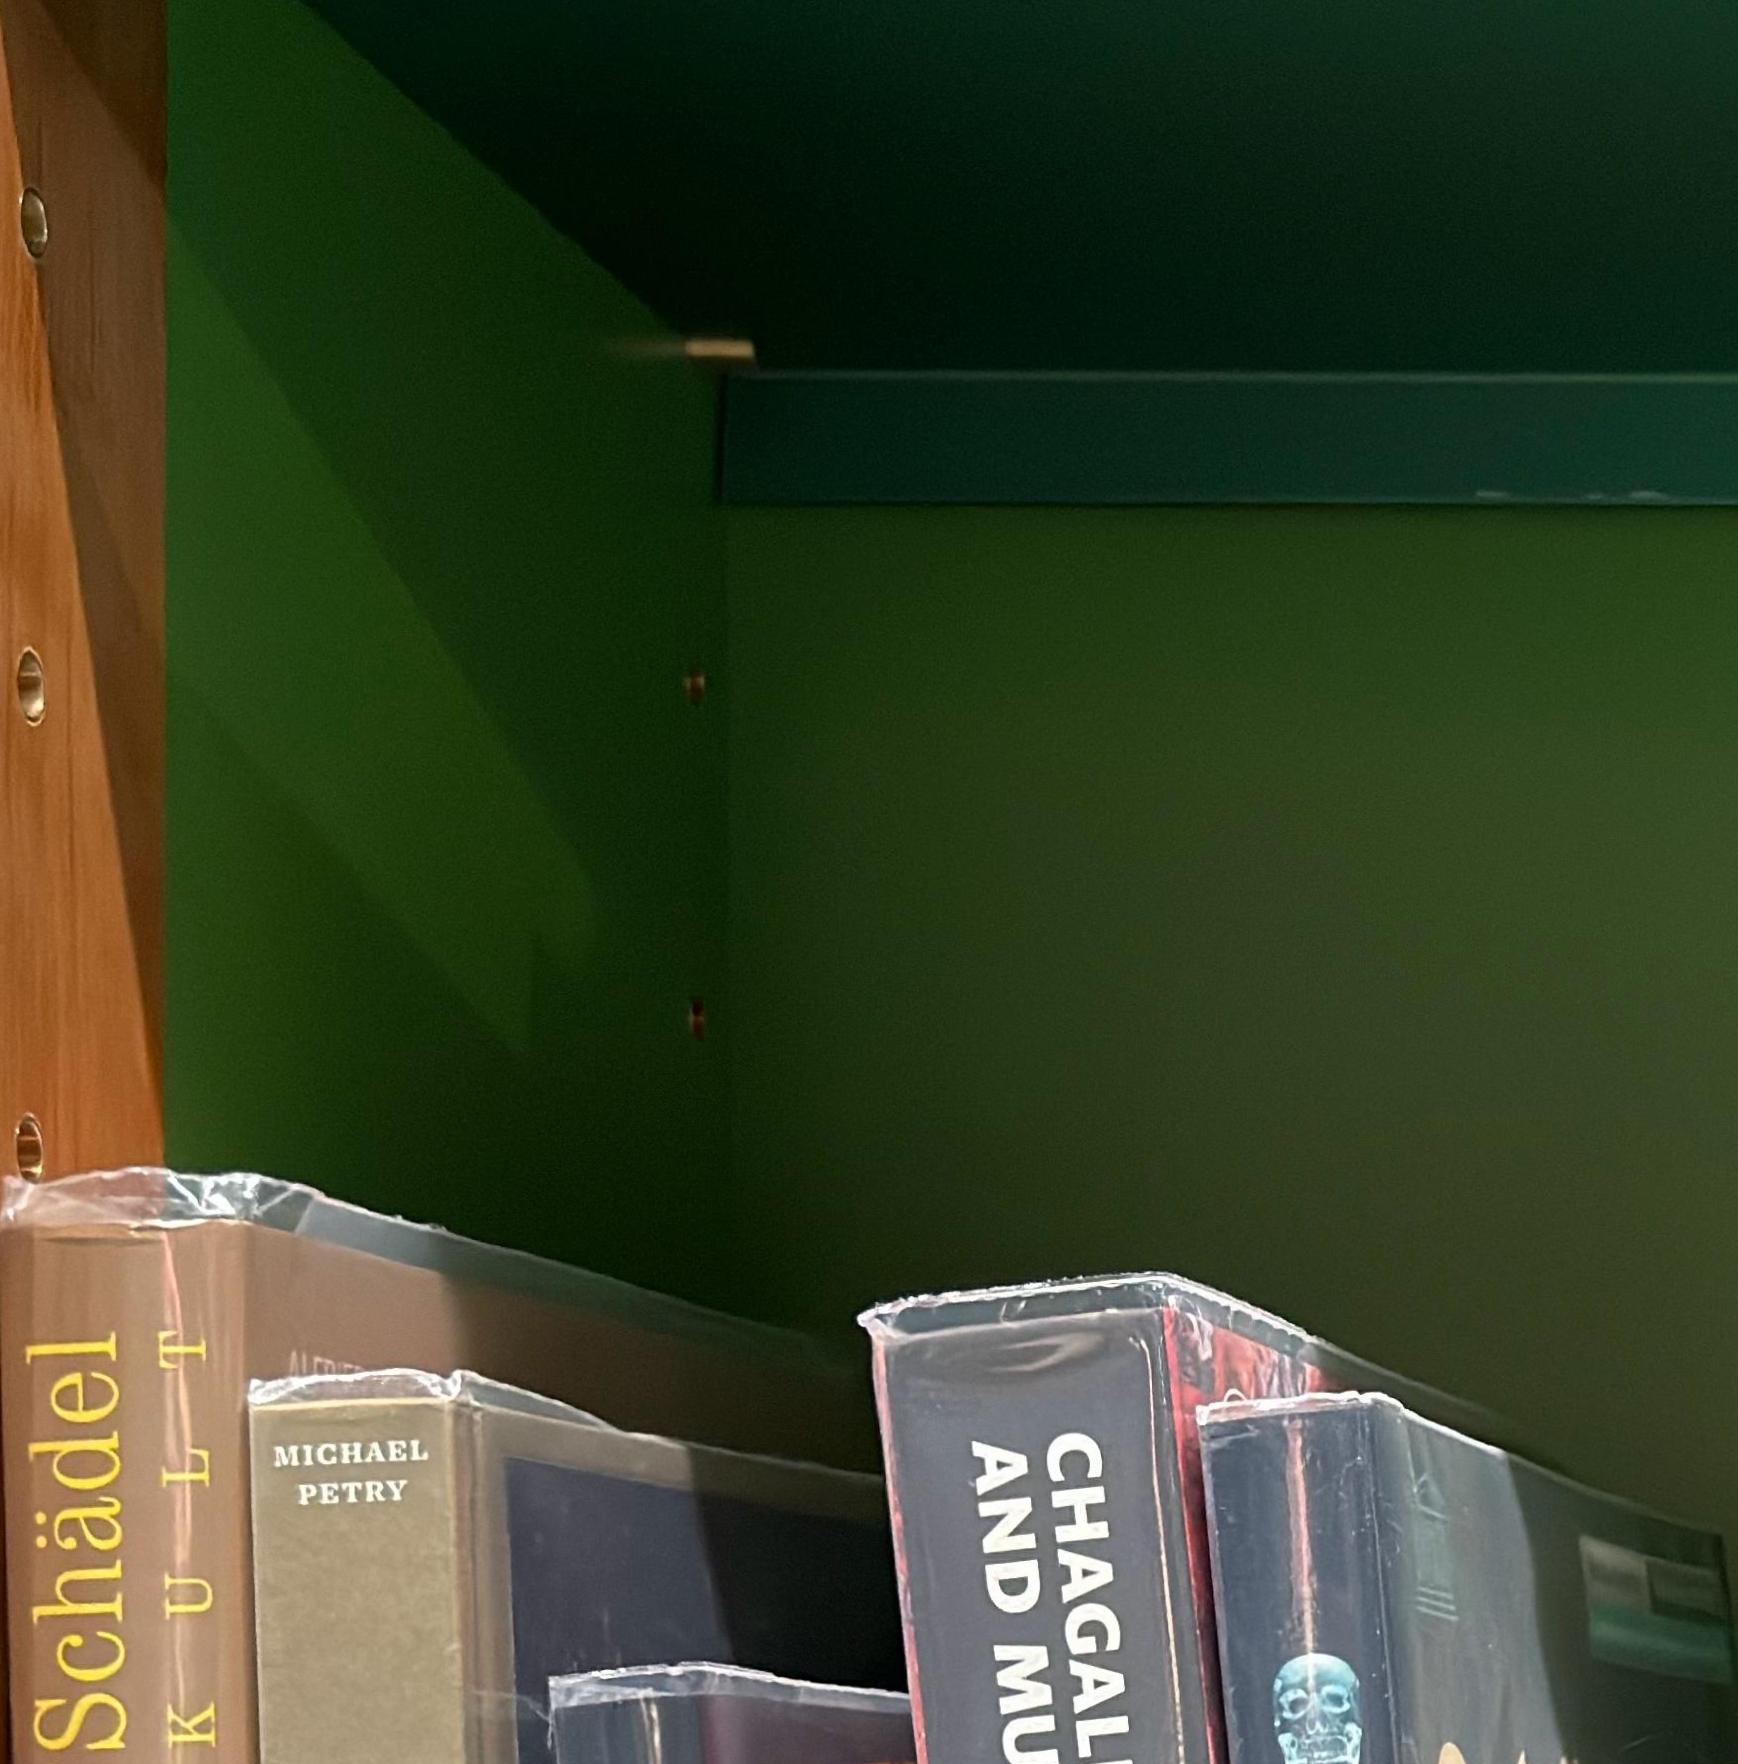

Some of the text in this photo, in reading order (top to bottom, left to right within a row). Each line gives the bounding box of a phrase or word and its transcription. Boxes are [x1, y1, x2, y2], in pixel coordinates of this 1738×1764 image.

[273, 1439, 429, 1468] MICHAEL
[299, 1479, 407, 1506] PETRY
[26, 1332, 127, 1751] Schädel
[970, 1440, 1042, 1615] AND
